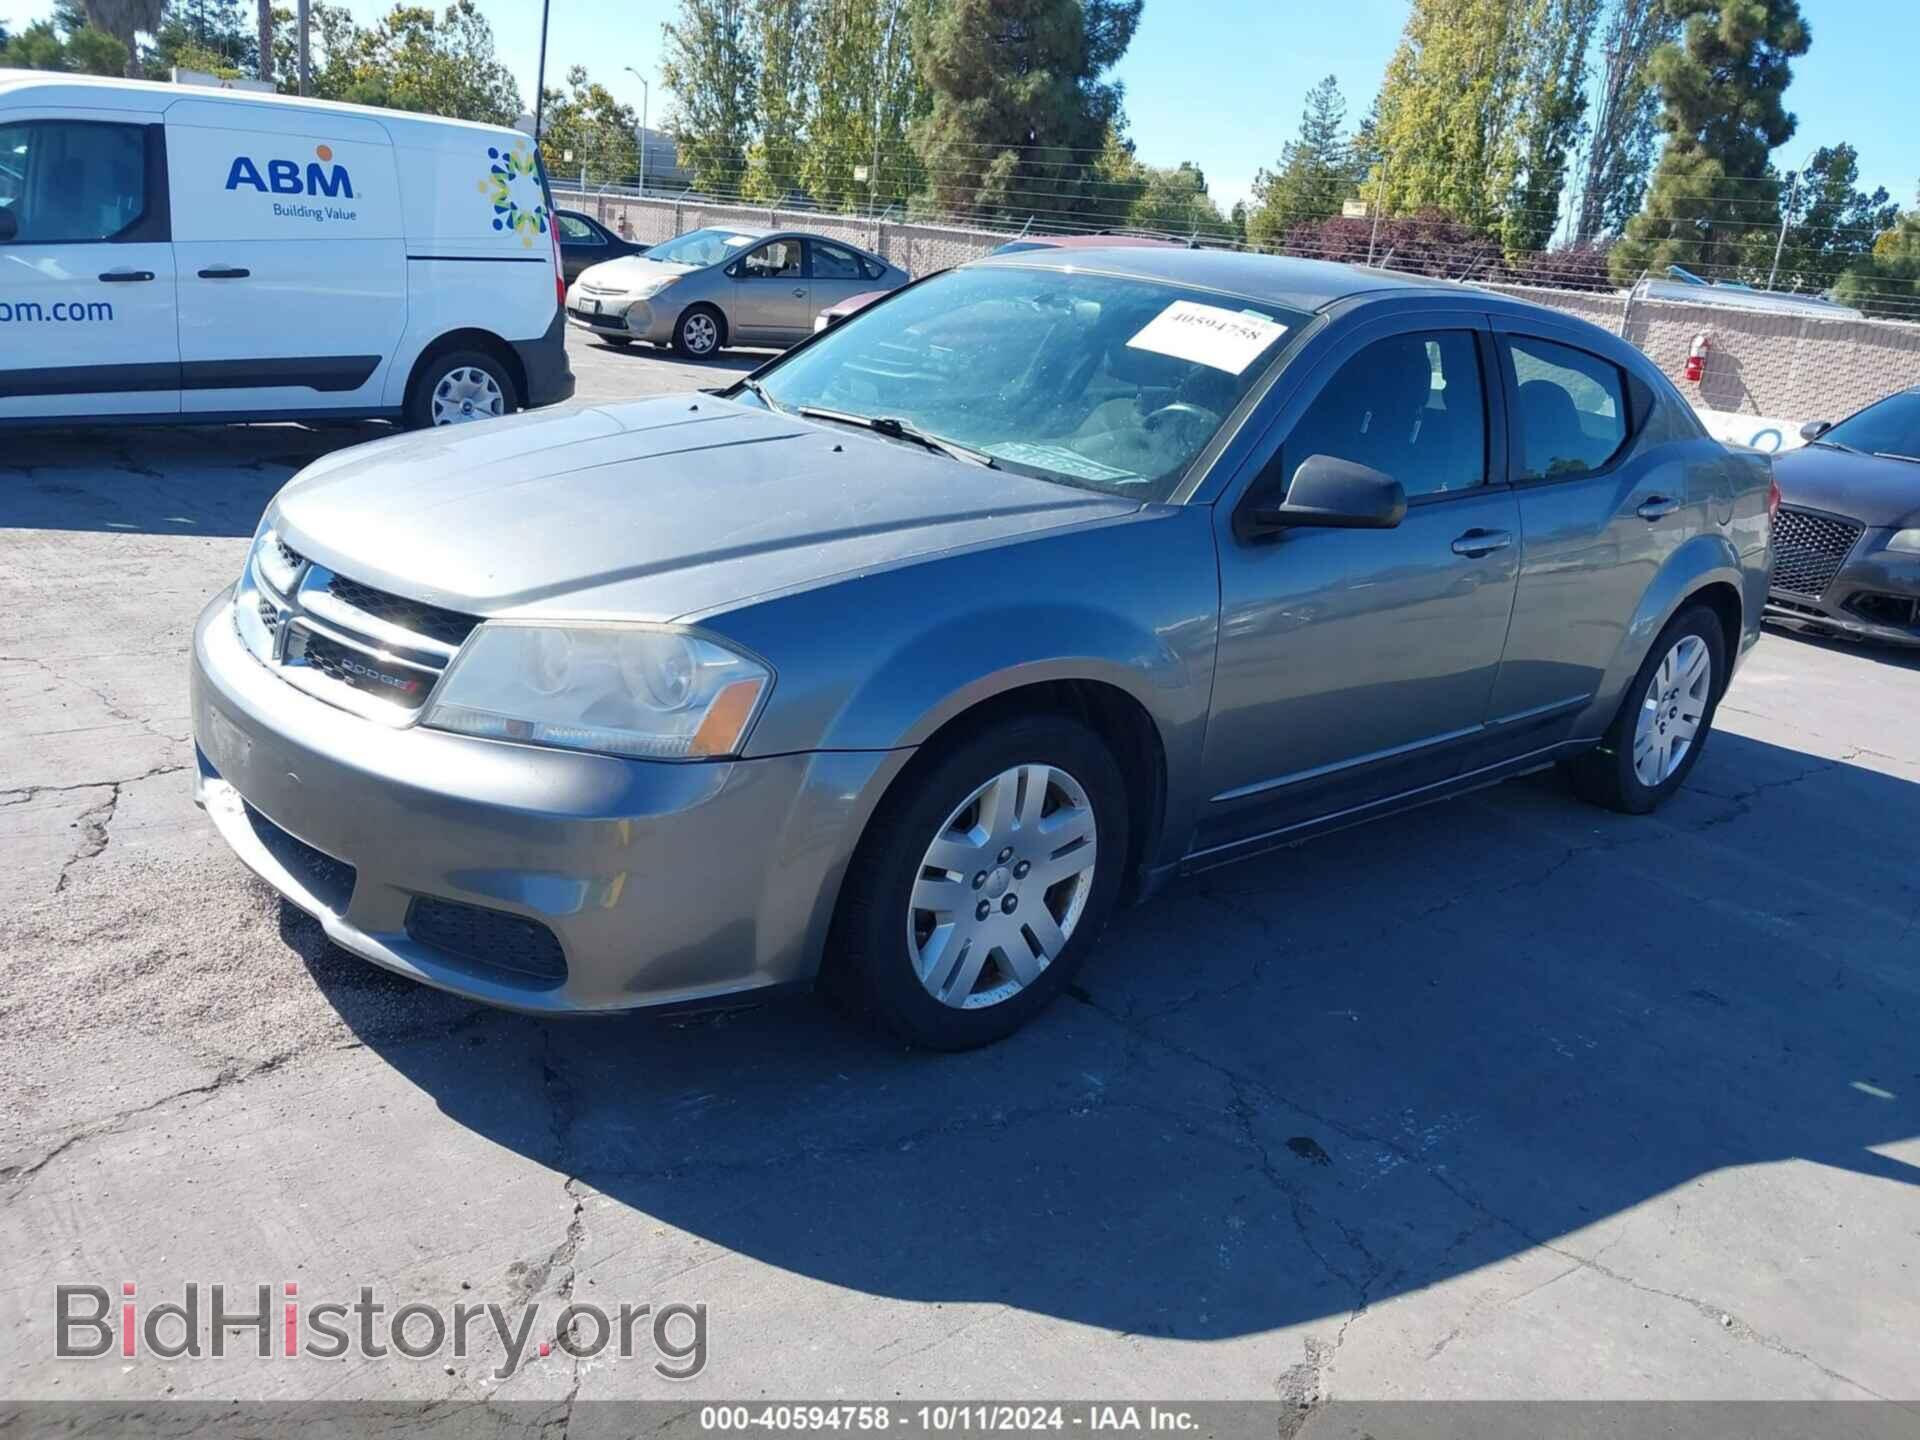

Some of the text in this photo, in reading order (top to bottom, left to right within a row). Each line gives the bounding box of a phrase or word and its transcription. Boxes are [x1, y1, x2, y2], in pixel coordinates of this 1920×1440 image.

[225, 156, 354, 199] ABM
[273, 203, 357, 222] Building Value
